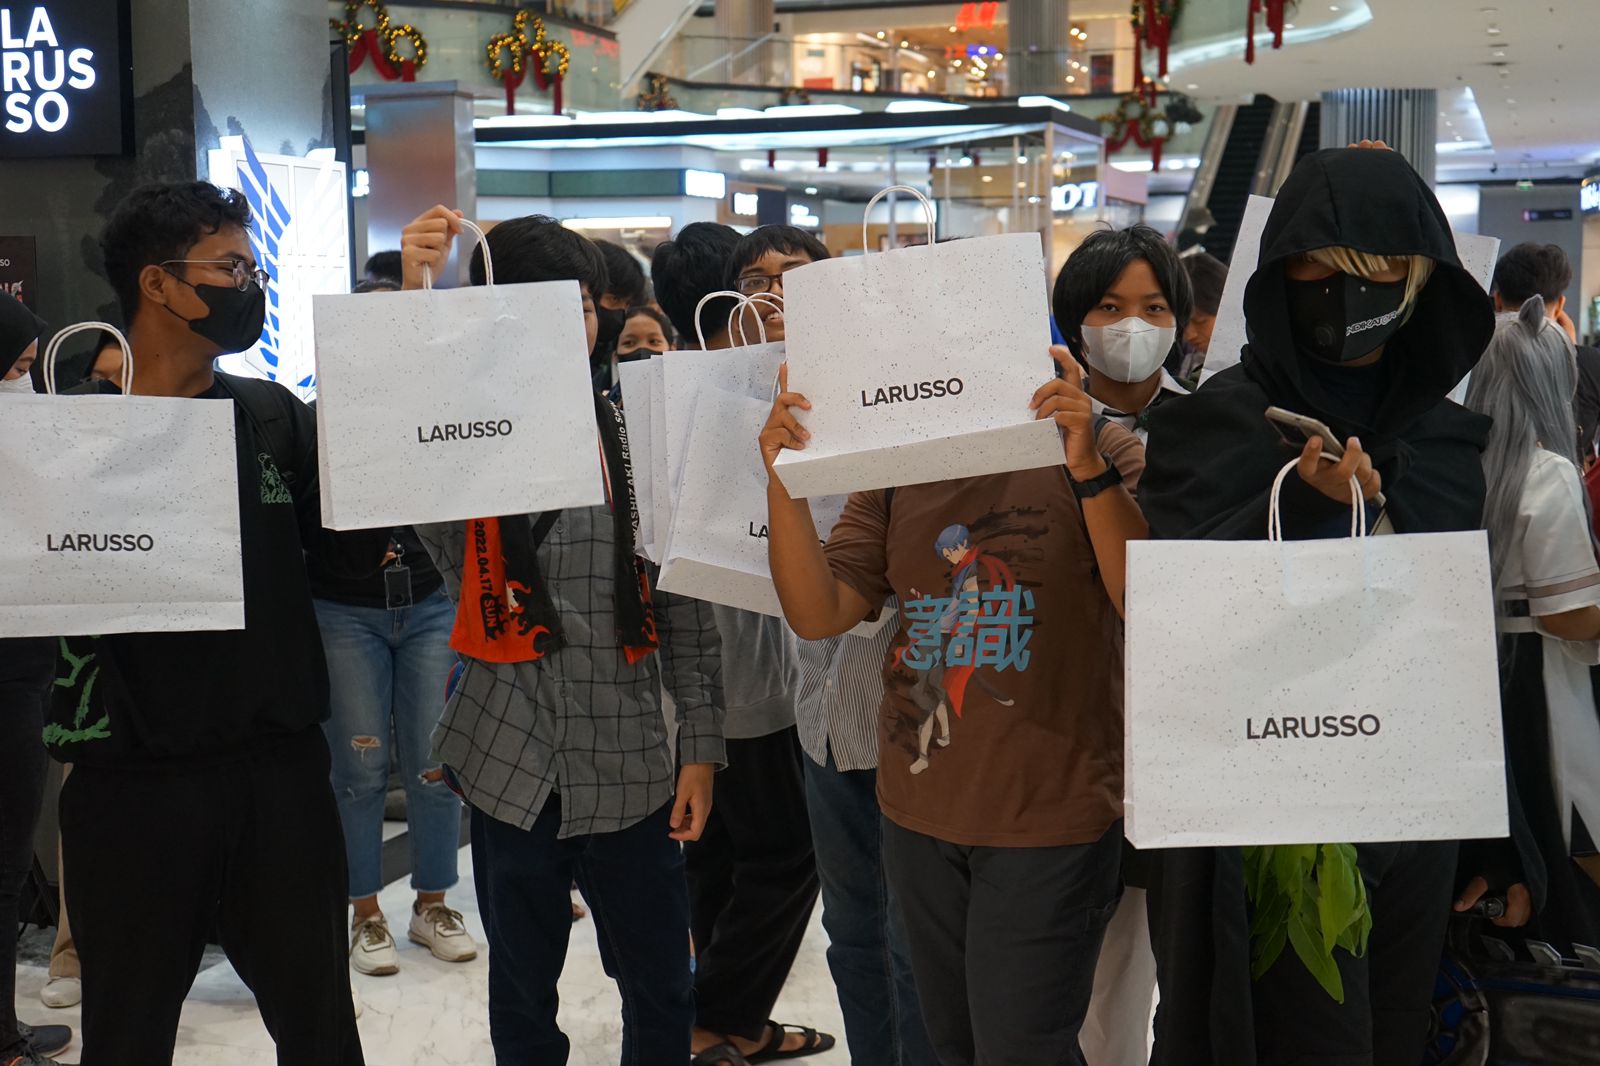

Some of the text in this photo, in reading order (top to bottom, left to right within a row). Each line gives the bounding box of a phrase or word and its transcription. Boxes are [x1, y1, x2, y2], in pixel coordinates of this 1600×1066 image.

[1, 6, 59, 49] LA
[2, 48, 96, 92] RUS
[5, 91, 69, 133] SO
[861, 377, 964, 407] LARUSSO
[417, 419, 513, 443] LARUSSO
[618, 426, 631, 461] Radio
[47, 533, 154, 552] LARUSSO
[474, 521, 498, 628] 2022.04.17 SUN
[901, 584, 1036, 673] 意識
[1246, 713, 1381, 740] LARUSSO
